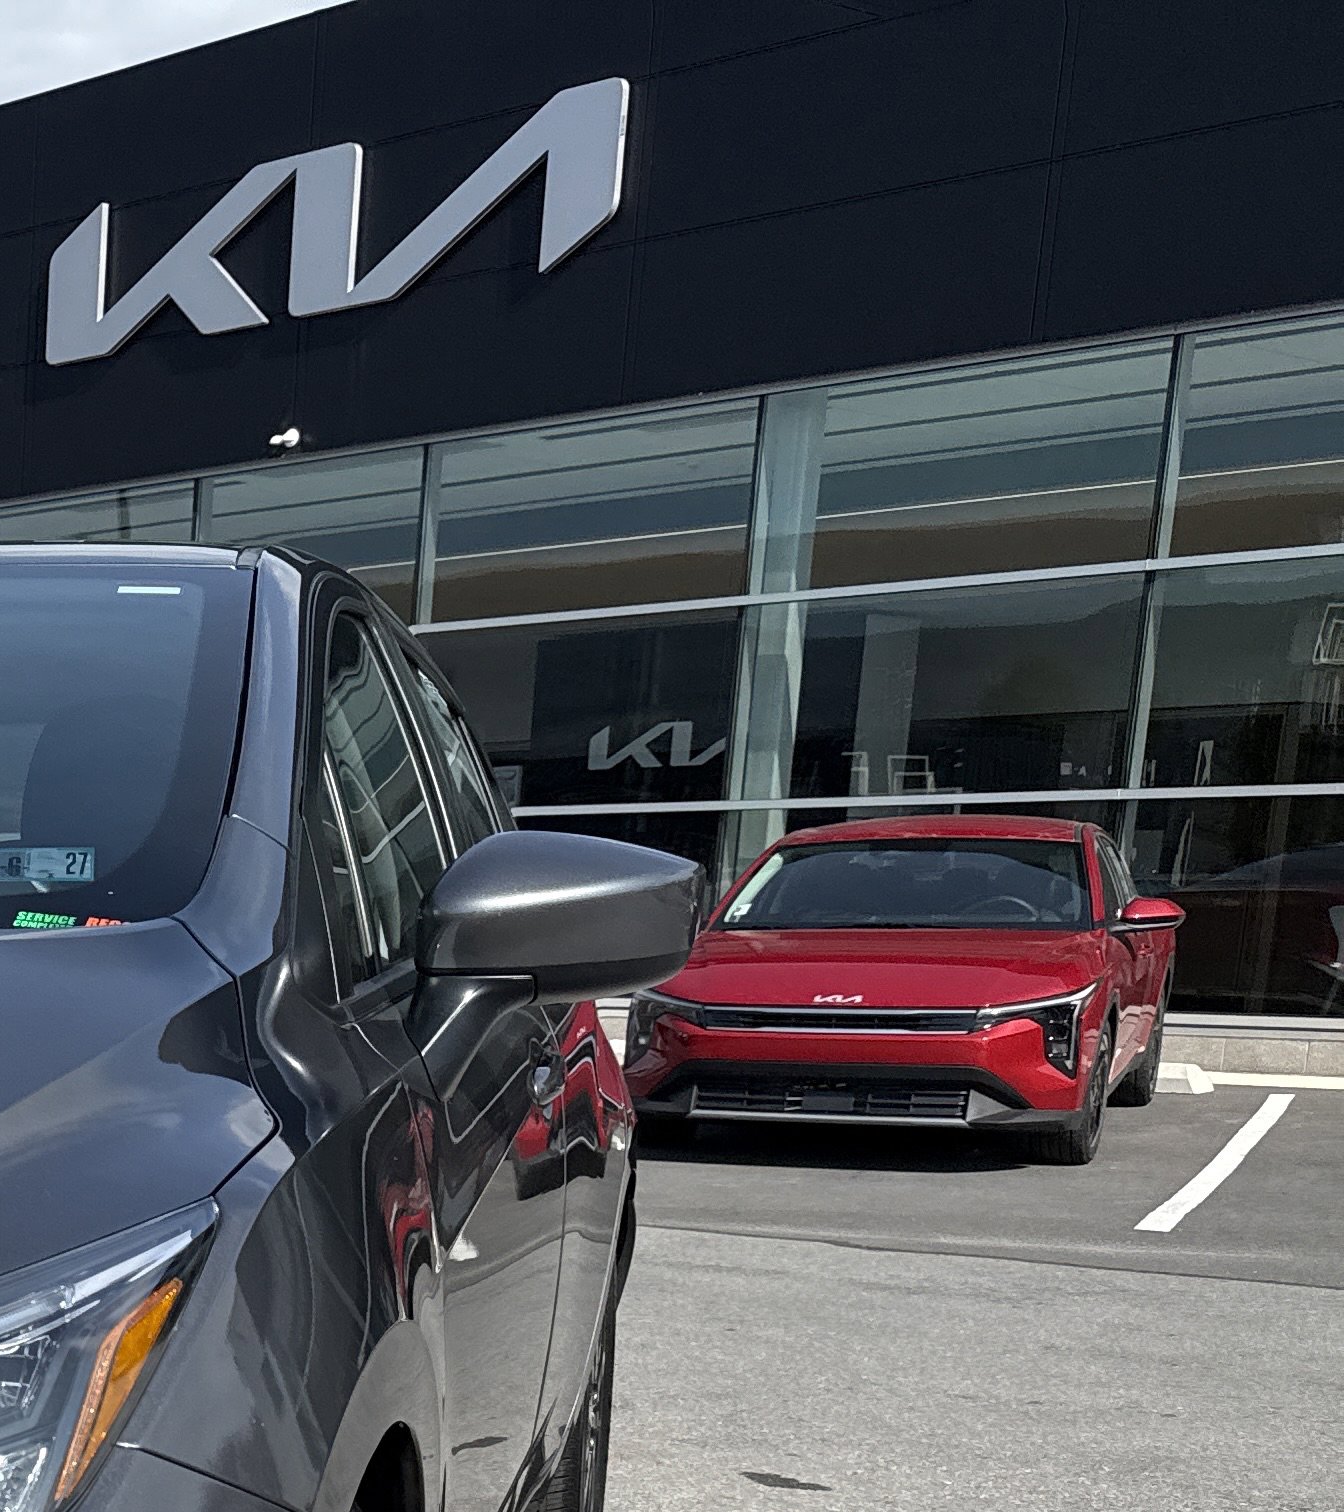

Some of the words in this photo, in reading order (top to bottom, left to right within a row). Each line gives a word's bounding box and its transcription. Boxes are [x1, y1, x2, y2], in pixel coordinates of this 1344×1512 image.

[45, 76, 630, 366] KIA
[66, 852, 88, 875] 27
[16, 911, 78, 926] SERVICE
